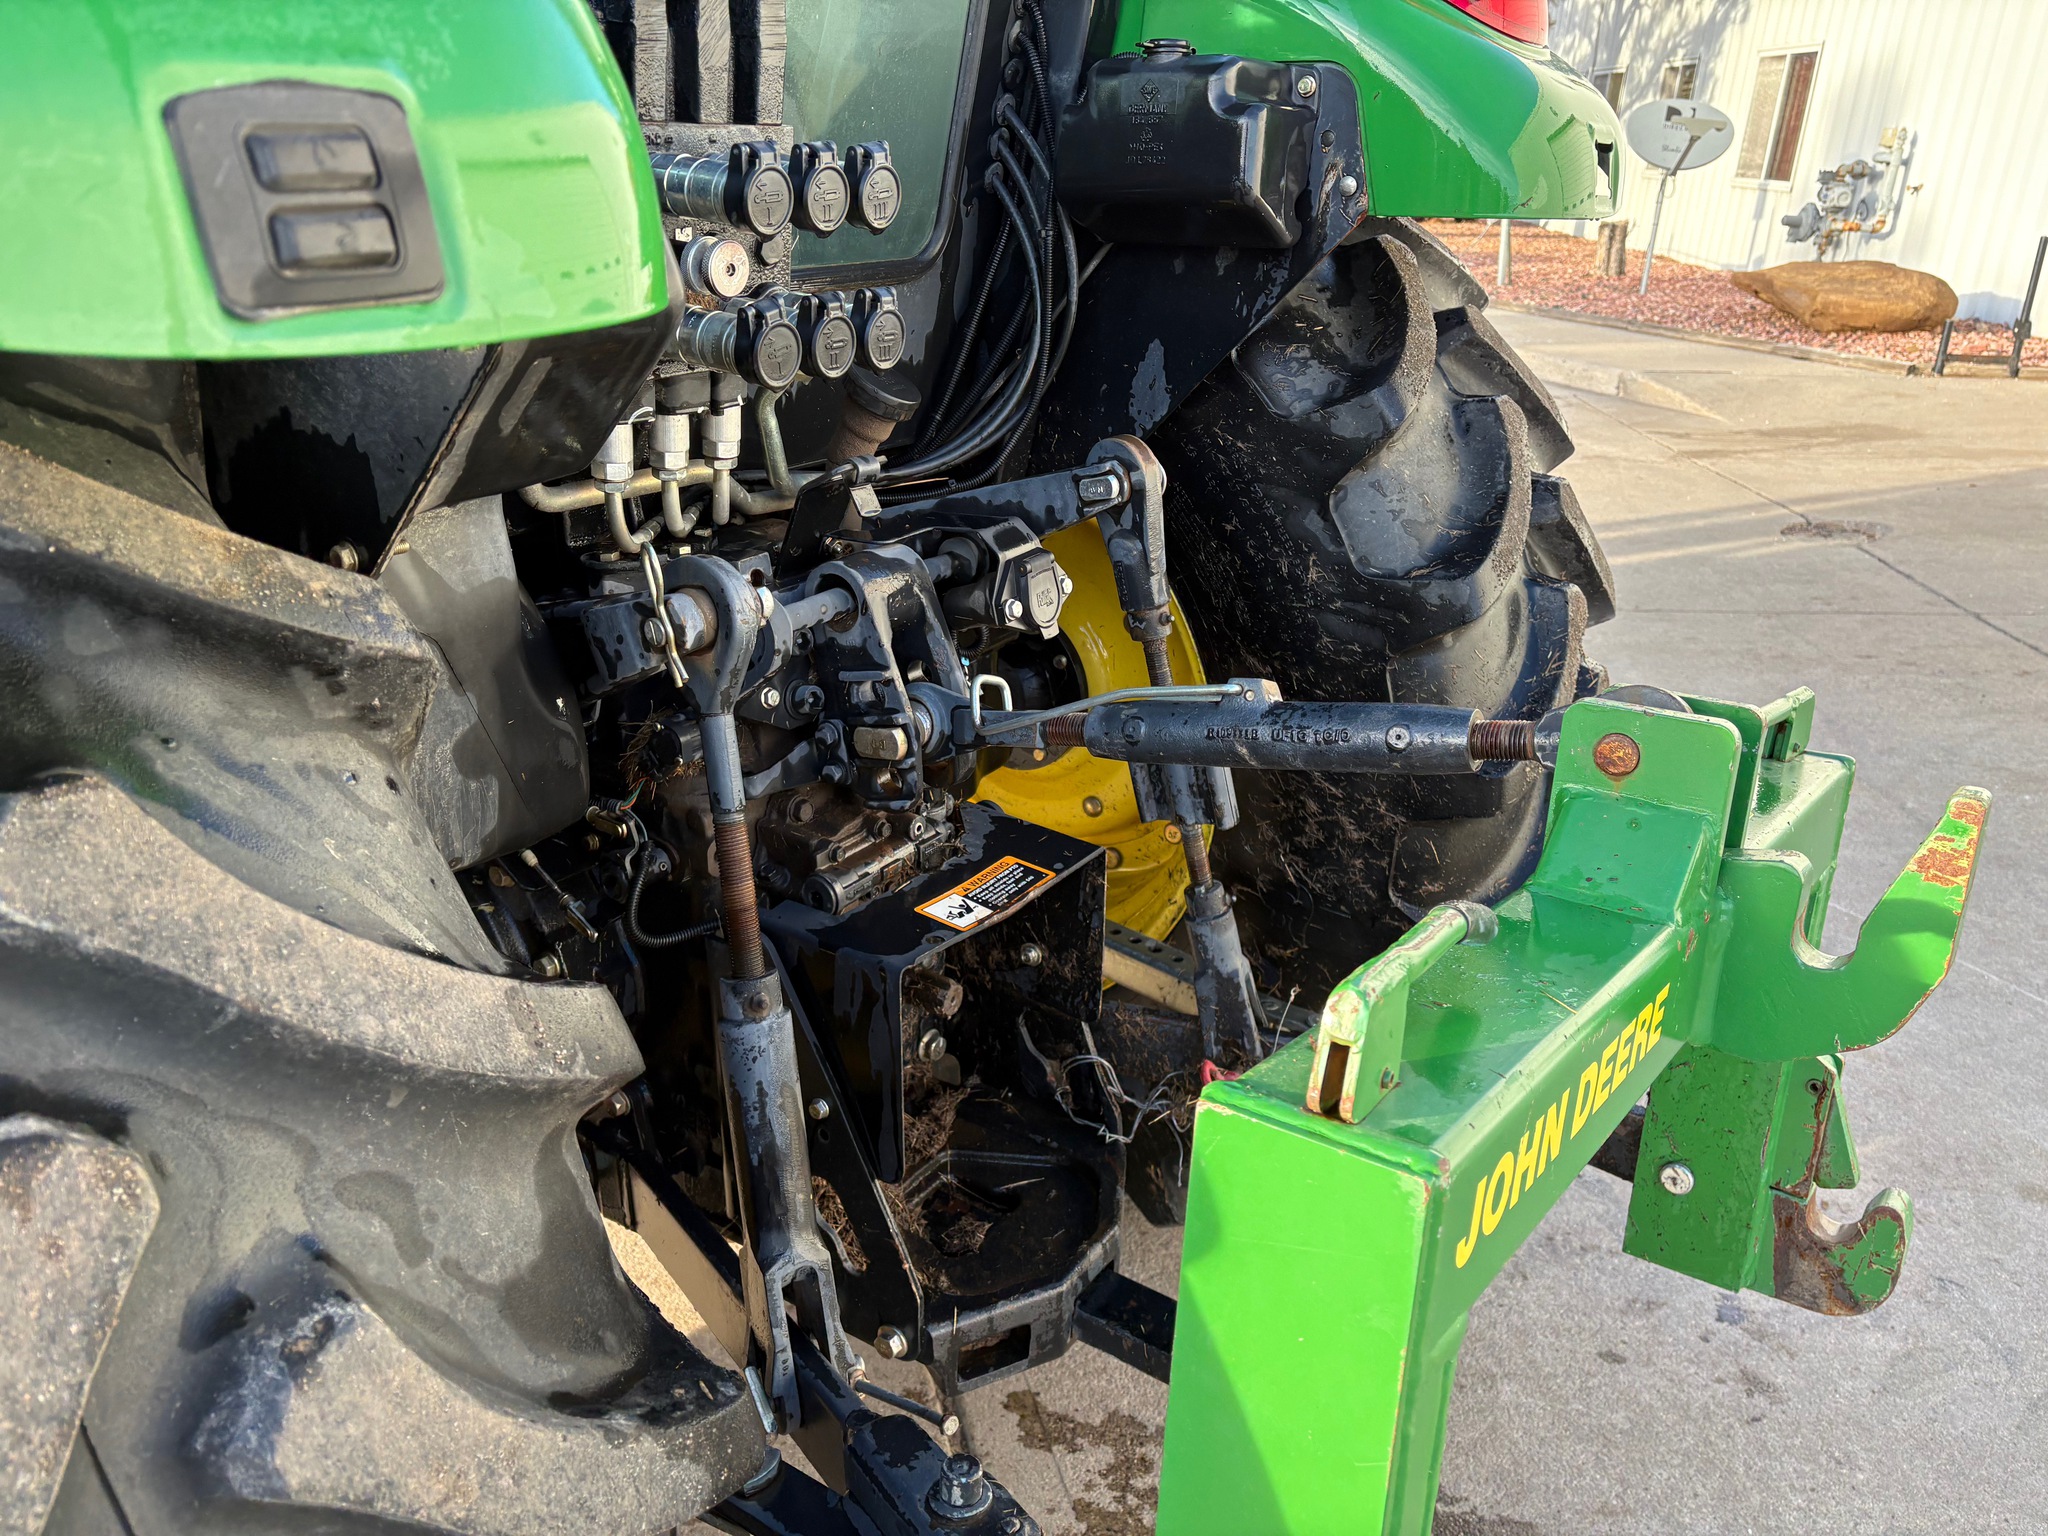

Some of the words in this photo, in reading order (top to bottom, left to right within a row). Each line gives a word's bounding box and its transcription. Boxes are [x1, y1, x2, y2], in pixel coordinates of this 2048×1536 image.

[822, 204, 833, 222] II
[873, 202, 888, 220] III
[829, 351, 840, 369] II
[878, 344, 892, 362] III
[969, 861, 1008, 887] WARNING
[1455, 1087, 1570, 1269] JOHN
[1570, 982, 1671, 1140] DEERE
